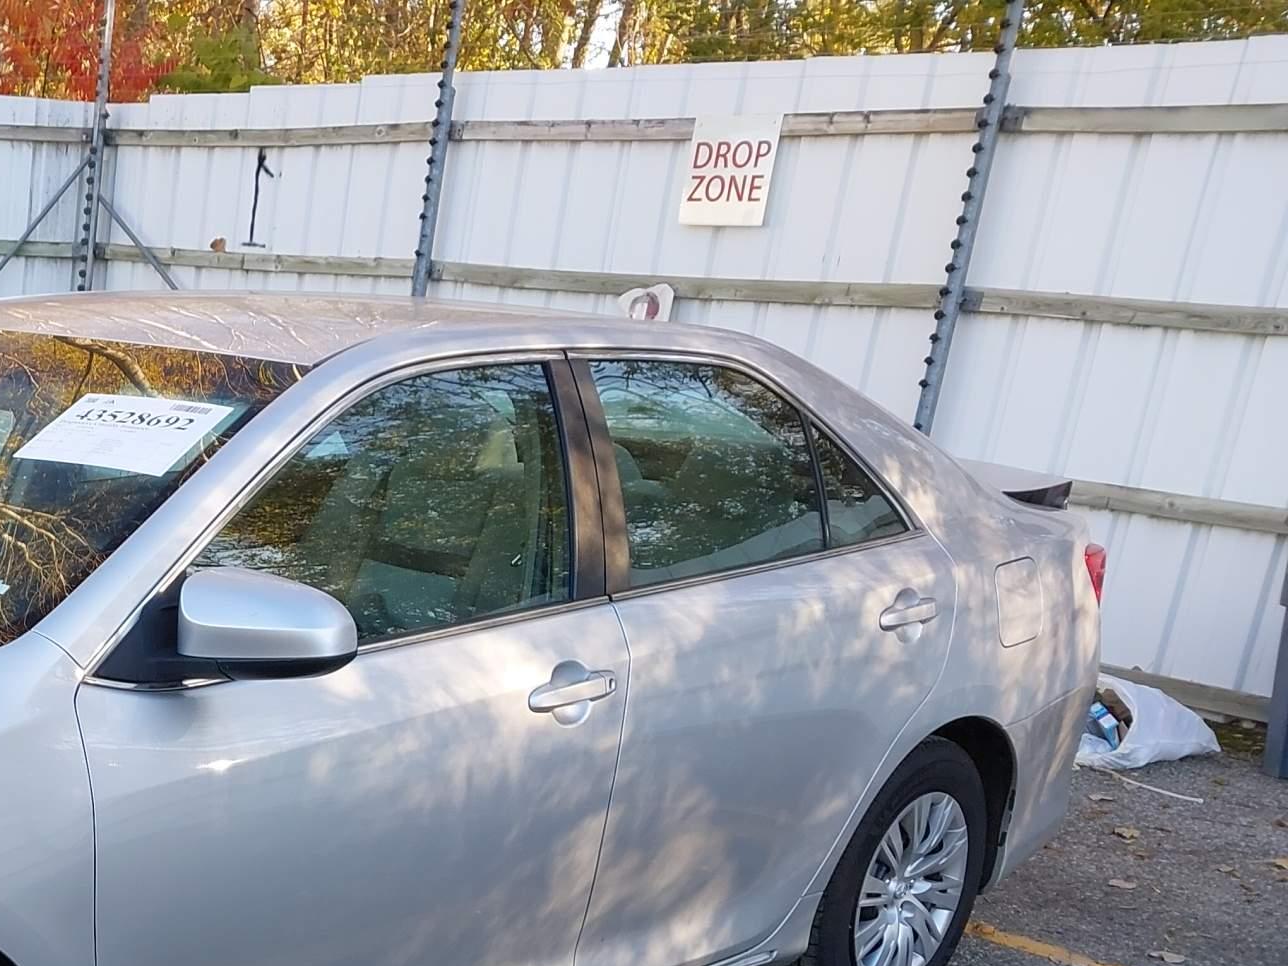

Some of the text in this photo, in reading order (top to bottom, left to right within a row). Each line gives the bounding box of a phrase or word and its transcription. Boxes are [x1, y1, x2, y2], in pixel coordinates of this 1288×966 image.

[693, 140, 772, 168] DROP
[687, 174, 764, 202] ZONE
[75, 407, 196, 431] 43528692
